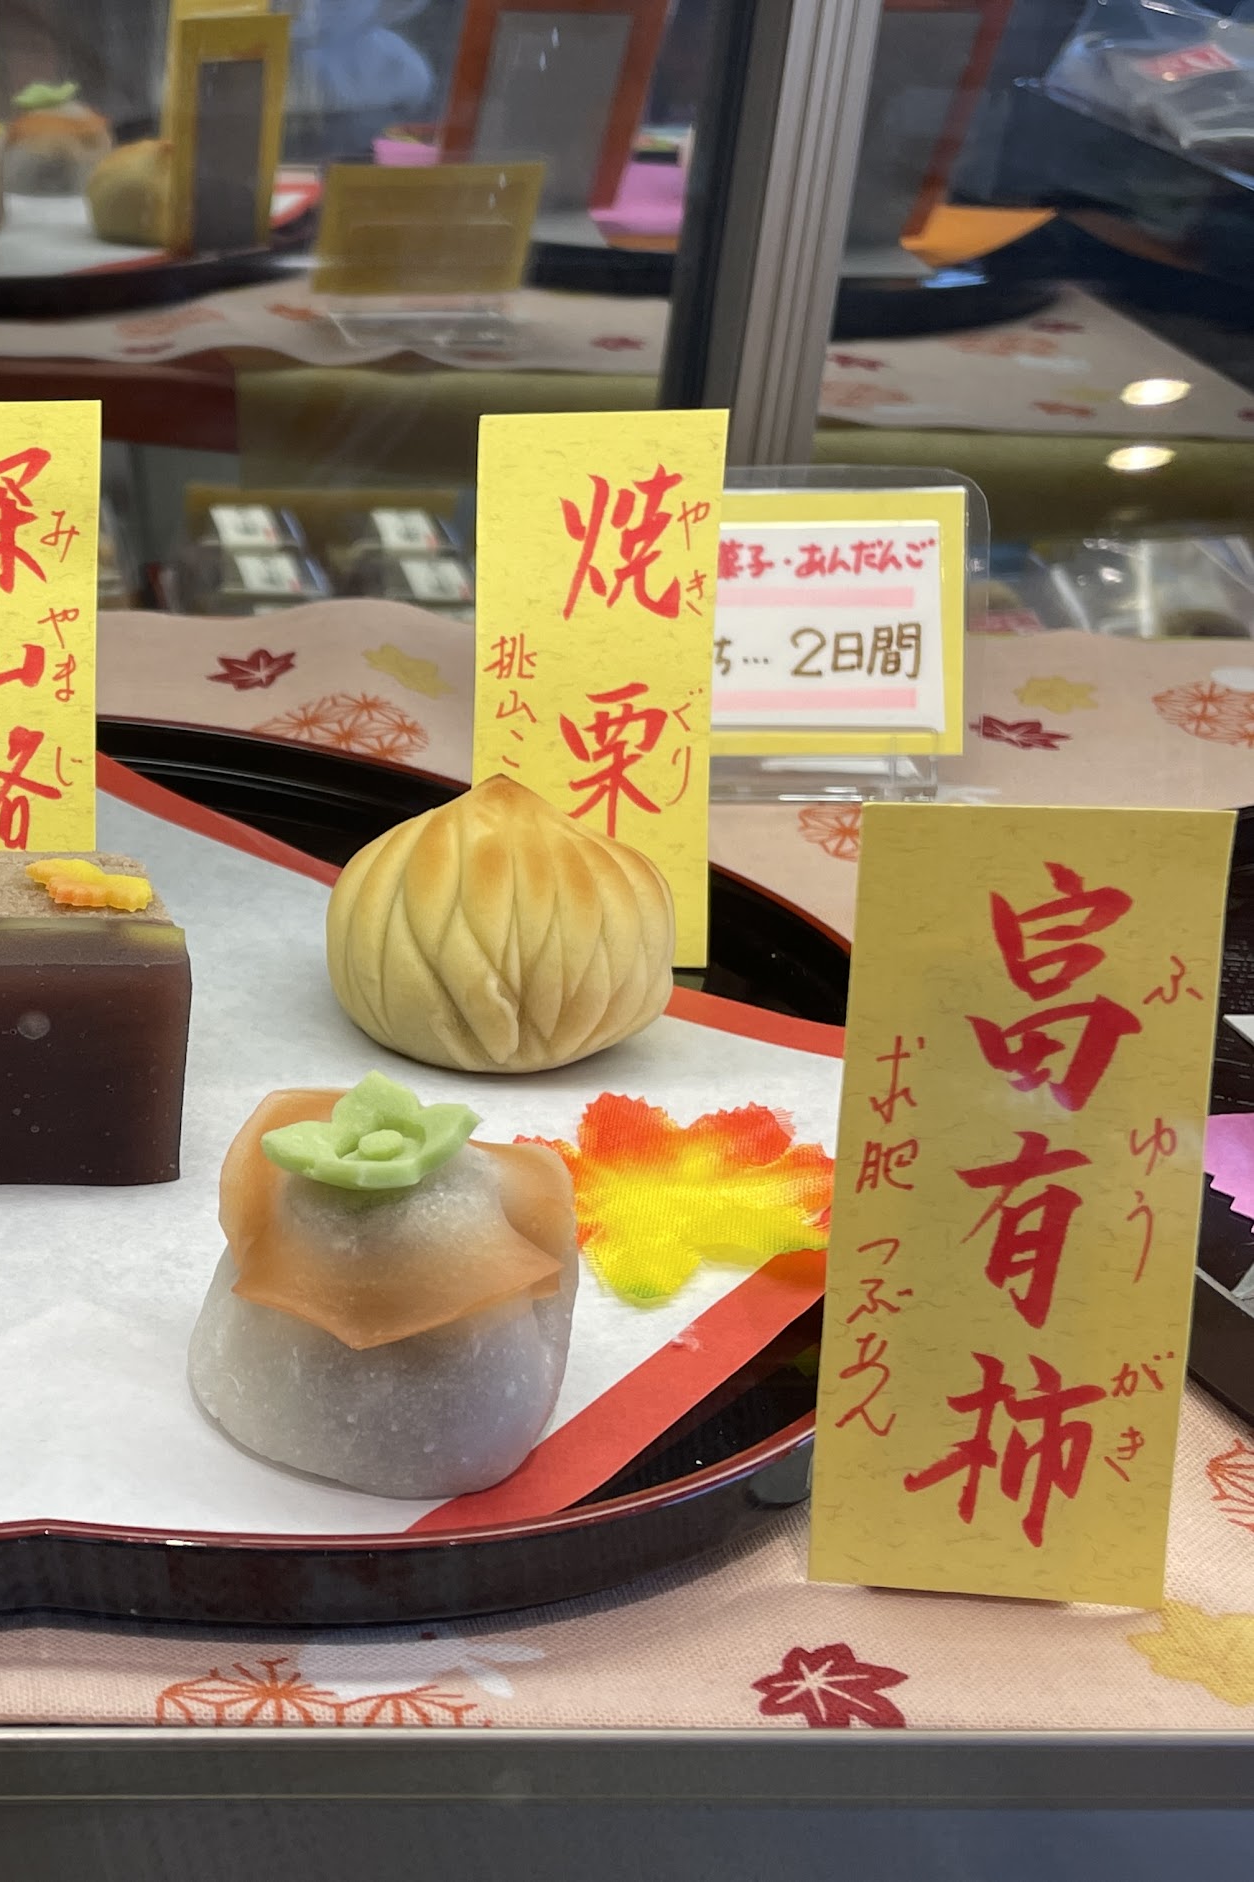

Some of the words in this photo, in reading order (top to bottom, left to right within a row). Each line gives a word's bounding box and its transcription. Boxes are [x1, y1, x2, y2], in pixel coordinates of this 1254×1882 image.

[37, 510, 82, 787] みやまじ
[558, 462, 684, 841] 焼栗
[664, 500, 712, 807] やきぐり
[903, 860, 1144, 1548] 富有柿
[1103, 955, 1205, 1483] ふゆうがき
